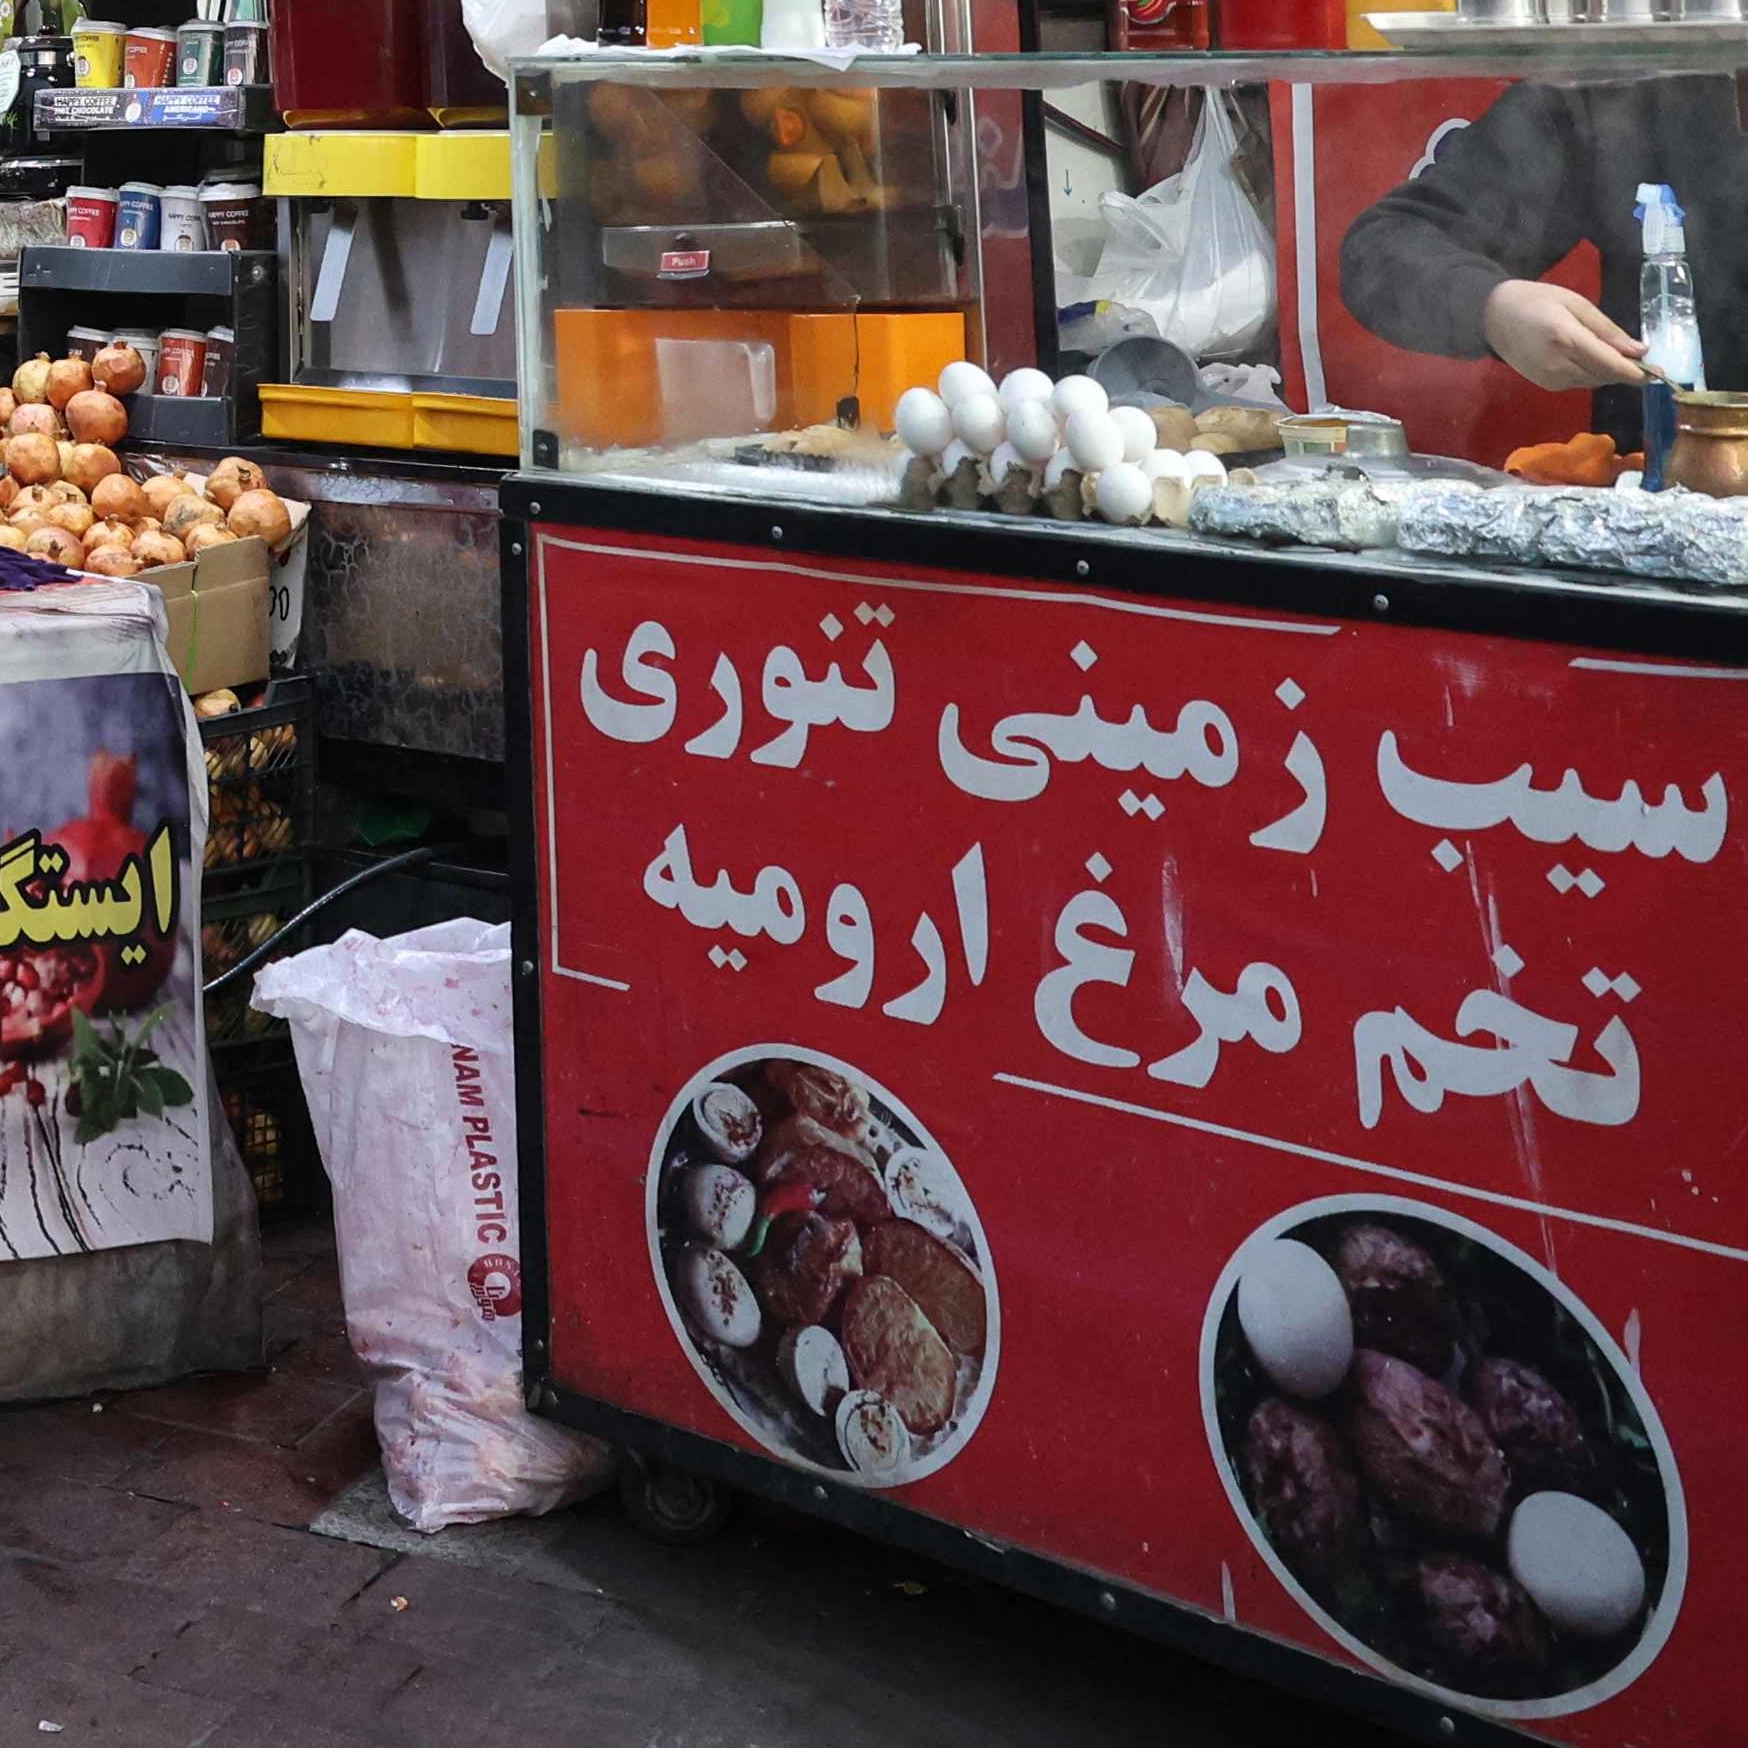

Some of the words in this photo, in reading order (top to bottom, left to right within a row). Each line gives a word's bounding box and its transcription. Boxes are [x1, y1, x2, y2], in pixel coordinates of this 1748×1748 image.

[580, 601, 896, 768] تنوری
[938, 642, 1328, 853] زمینی
[1376, 730, 1727, 898] سیب
[643, 825, 988, 1026] ارومیه
[1034, 853, 1302, 1089] مرغ
[1352, 945, 1641, 1129] تخم
[462, 1114, 508, 1245] PLASTIC
